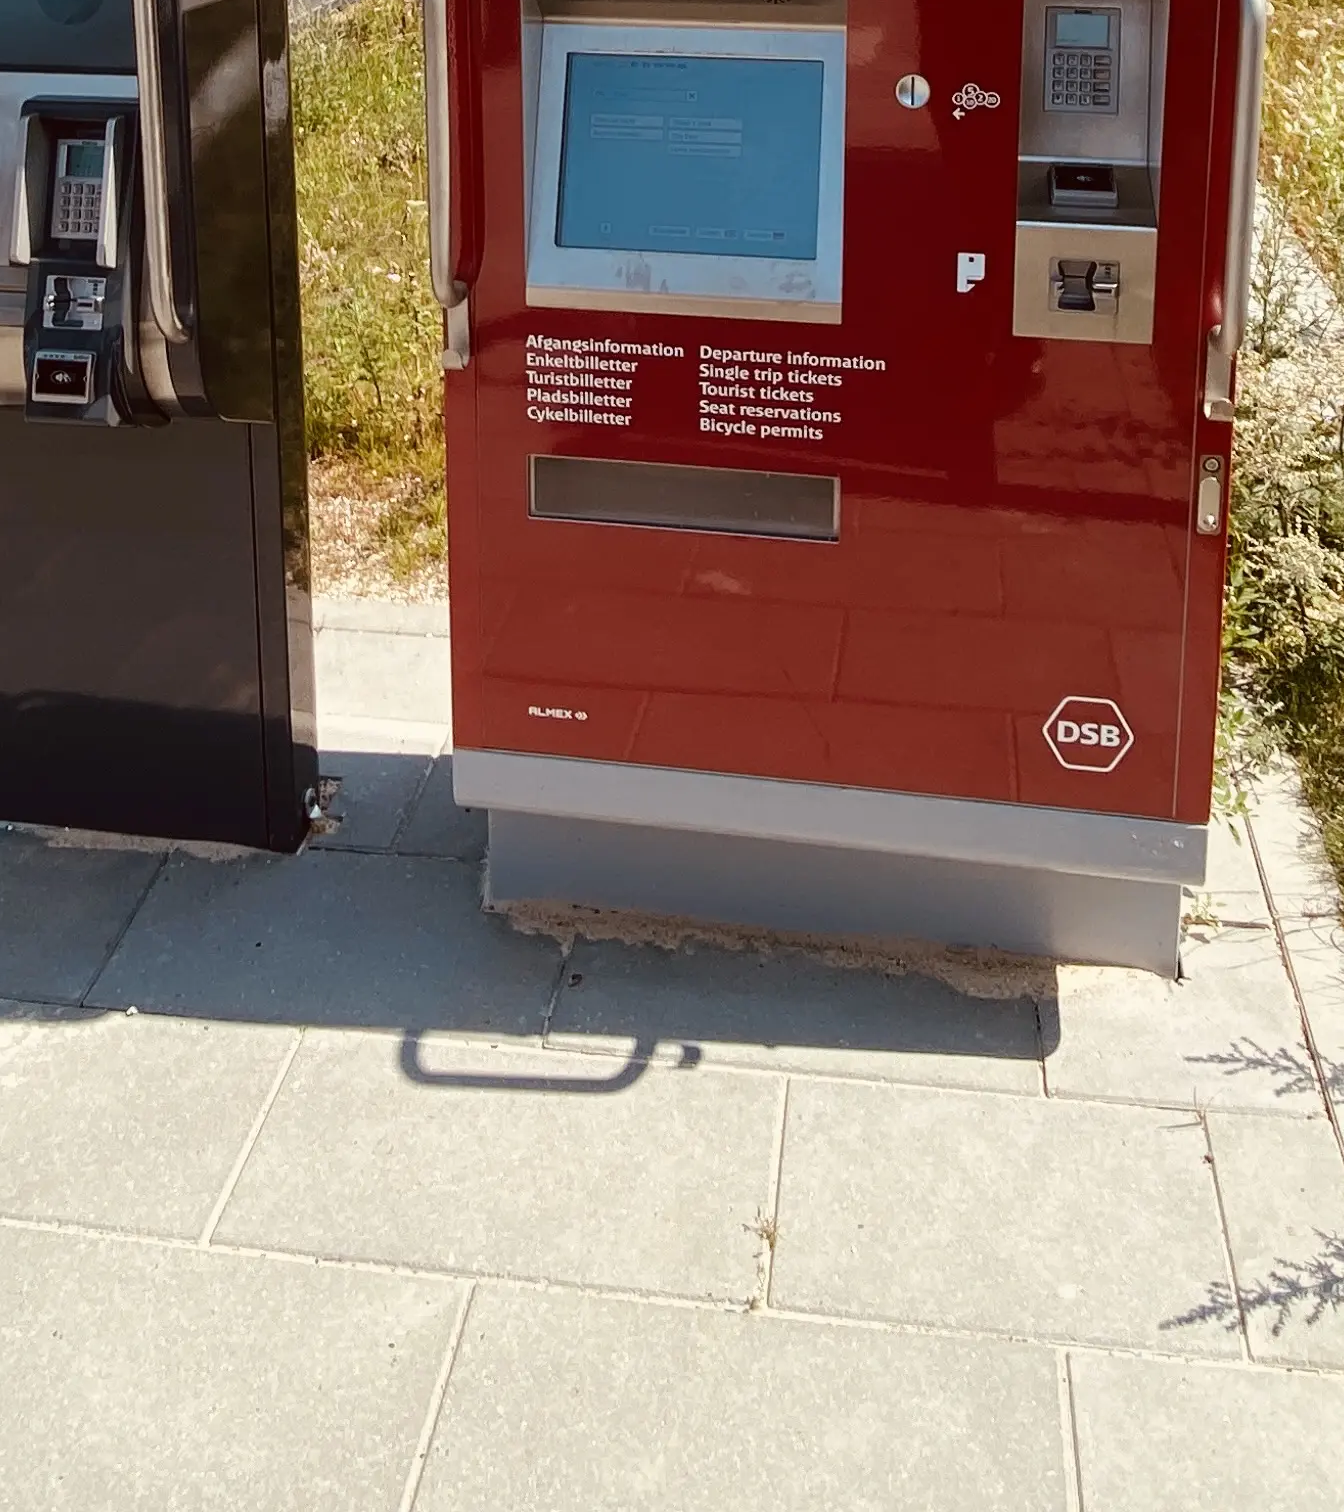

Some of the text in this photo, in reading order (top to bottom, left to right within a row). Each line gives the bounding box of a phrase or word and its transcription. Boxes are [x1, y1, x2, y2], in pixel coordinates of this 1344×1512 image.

[525, 334, 685, 357] Afgangsinformation
[526, 353, 639, 373] Enkeltbilletter
[699, 345, 886, 371] Departure information
[525, 370, 633, 390] Turistbilletter
[699, 363, 843, 387] Single trip tickets
[526, 388, 633, 408] Pladsbilletter
[698, 382, 814, 403] Tourist tickets
[527, 406, 633, 426] Cykelbilletter
[699, 400, 842, 423] Seat reservations
[699, 418, 823, 440] Bicycle permits
[528, 706, 573, 719] ALMEX
[1057, 720, 1121, 747] DSB
